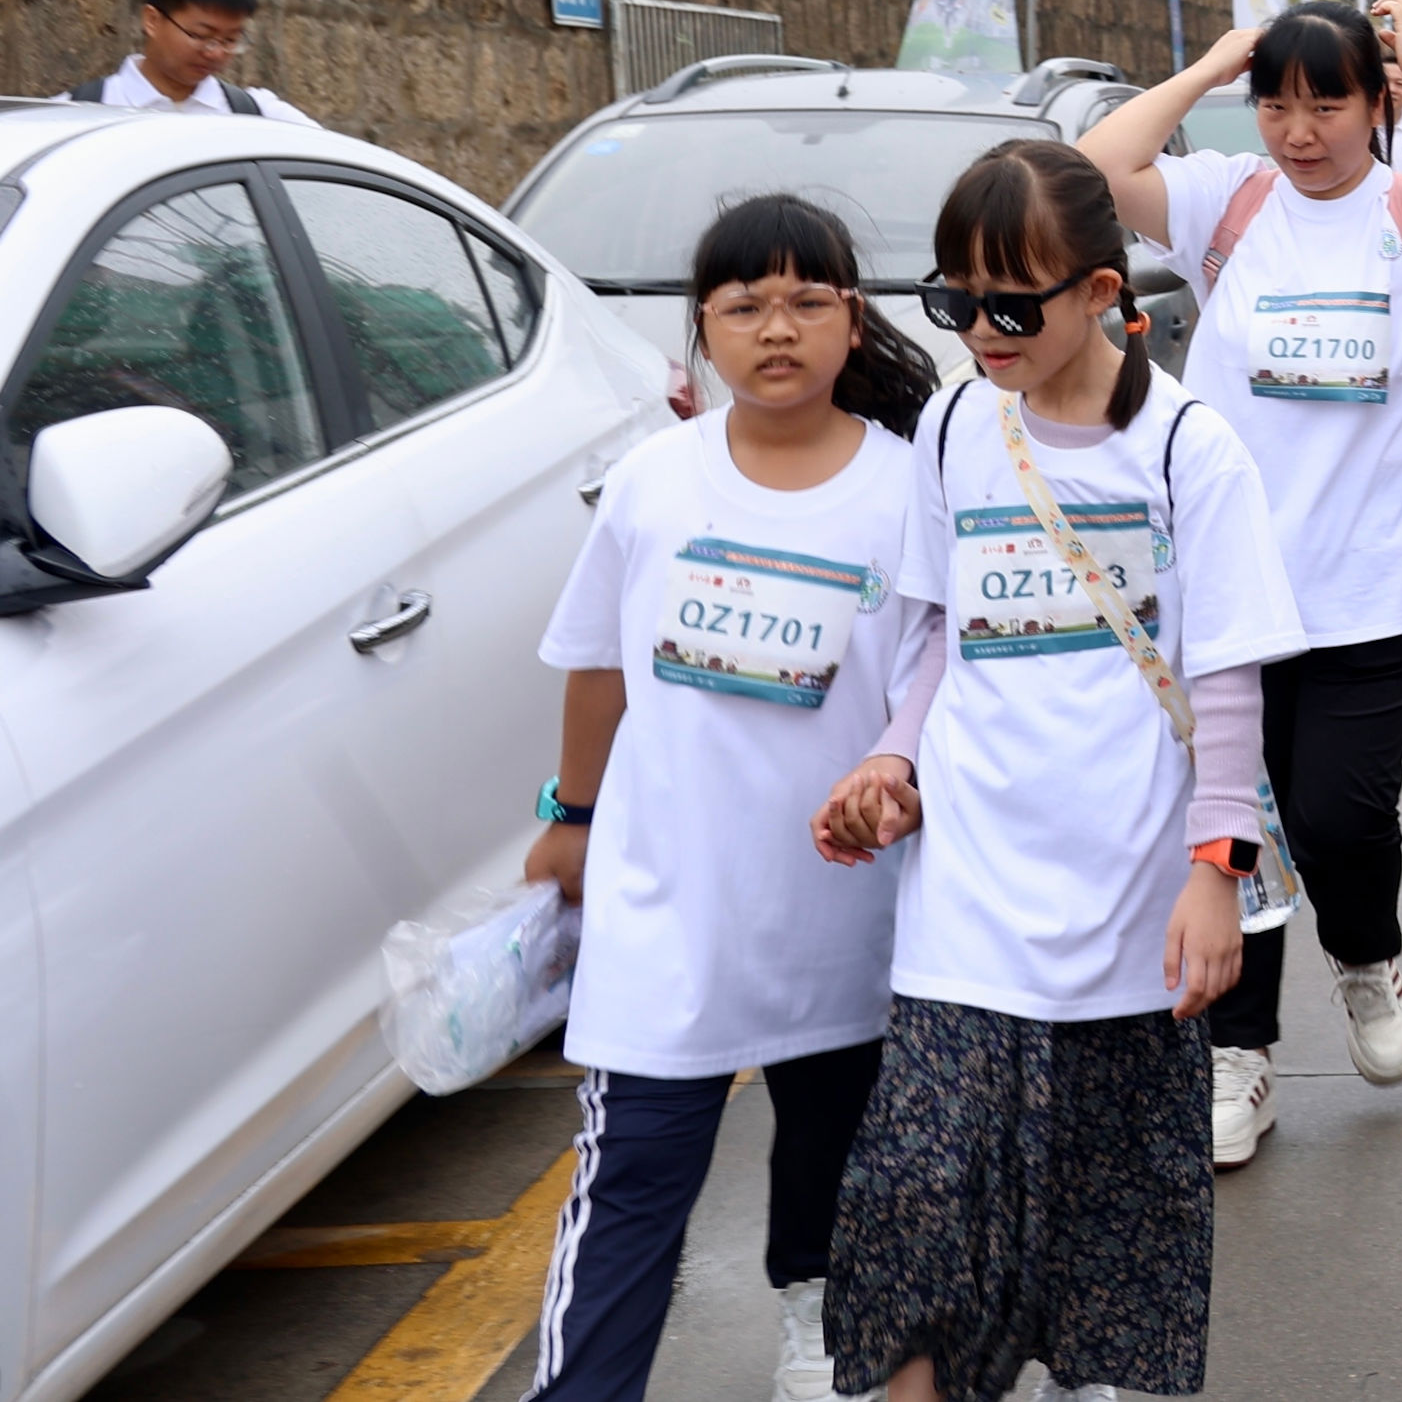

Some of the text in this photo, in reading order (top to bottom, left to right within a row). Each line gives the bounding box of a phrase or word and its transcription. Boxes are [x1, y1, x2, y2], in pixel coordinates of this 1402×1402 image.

[1268, 337, 1375, 360] QZ1700
[981, 564, 1128, 601] QZ173
[679, 599, 823, 651] QZ1701
